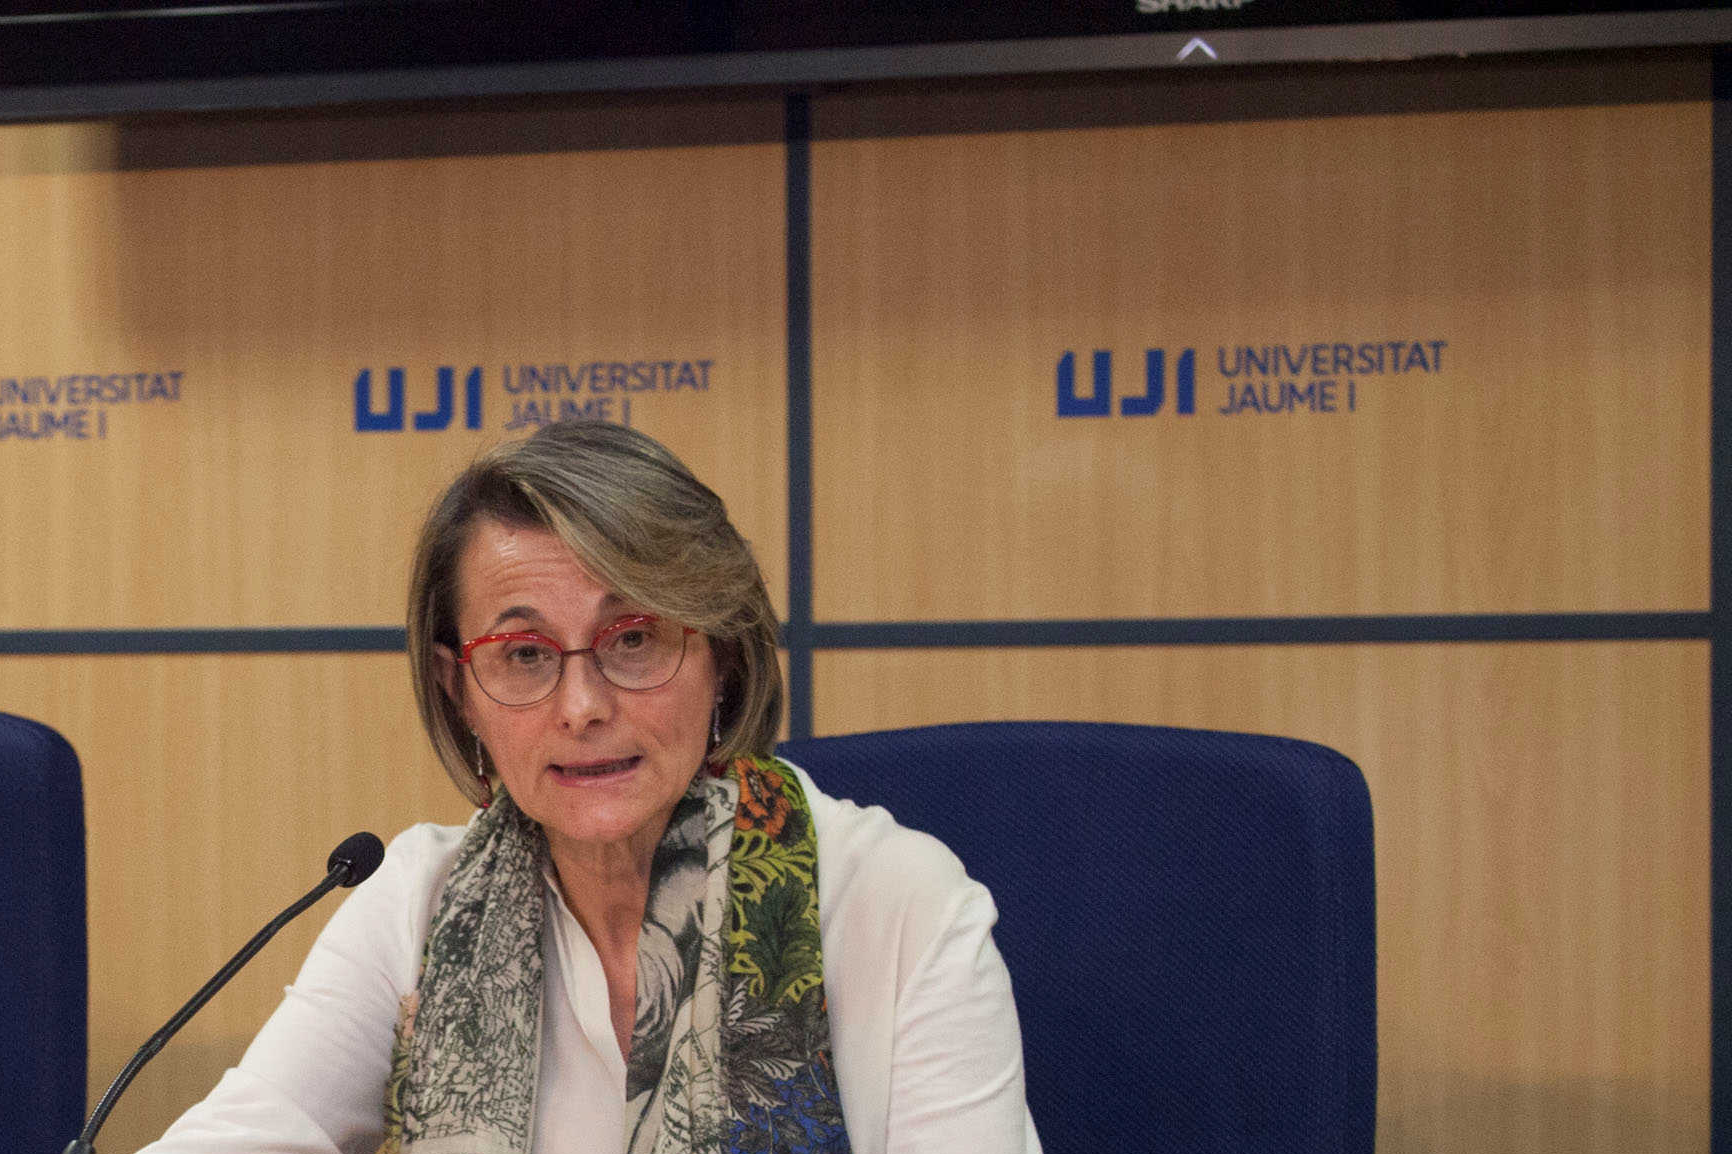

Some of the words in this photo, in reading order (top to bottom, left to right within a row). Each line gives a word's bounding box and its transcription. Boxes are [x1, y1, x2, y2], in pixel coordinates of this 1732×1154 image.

[1217, 341, 1448, 376] UNIVERSITAT
[502, 360, 714, 394] UNIVERSITAT
[1056, 347, 1196, 418] UJI
[353, 366, 483, 432] UJI
[1218, 380, 1337, 414] JAUME
[1348, 380, 1356, 412] I
[98, 410, 107, 440] I
